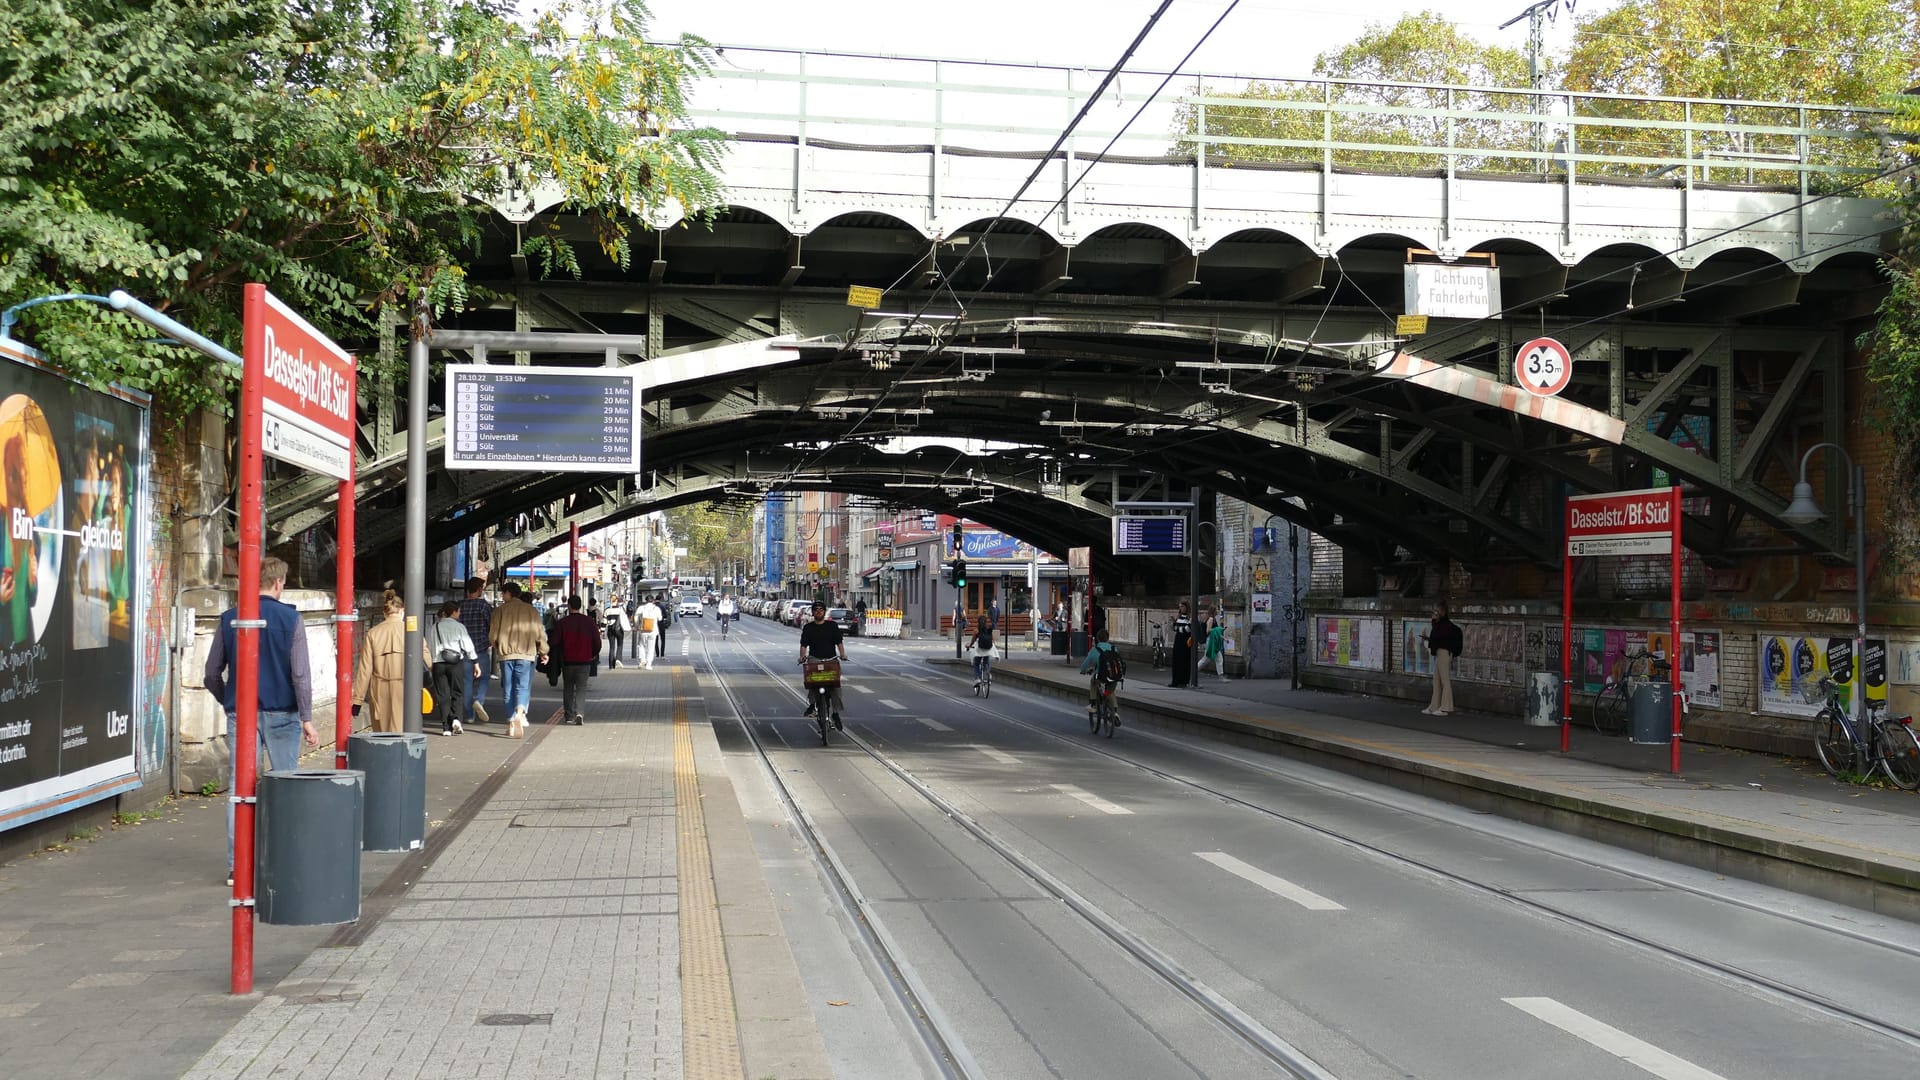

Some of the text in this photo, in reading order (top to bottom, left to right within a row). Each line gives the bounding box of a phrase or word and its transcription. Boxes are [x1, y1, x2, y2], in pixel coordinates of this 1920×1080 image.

[1434, 269, 1484, 289] Achtung
[458, 374, 487, 382] 28.10.22
[480, 384, 495, 392] Sülz
[604, 387, 613, 395] 11
[614, 387, 629, 395] Min
[333, 371, 349, 421] Süd
[480, 394, 495, 402] Sülz
[604, 397, 613, 405] 20
[614, 397, 629, 405] Min
[480, 413, 495, 421] Sülz
[604, 416, 613, 424] 39
[614, 416, 629, 424] Min
[480, 423, 495, 431] Sülz
[480, 433, 519, 441] Universität
[487, 453, 535, 461] Einzelbahnen
[542, 454, 578, 462] Hierdurch
[1645, 501, 1670, 524] Süd
[12, 507, 122, 554] Bin gleich da
[22, 720, 32, 736] dir
[107, 710, 128, 738] Uber
